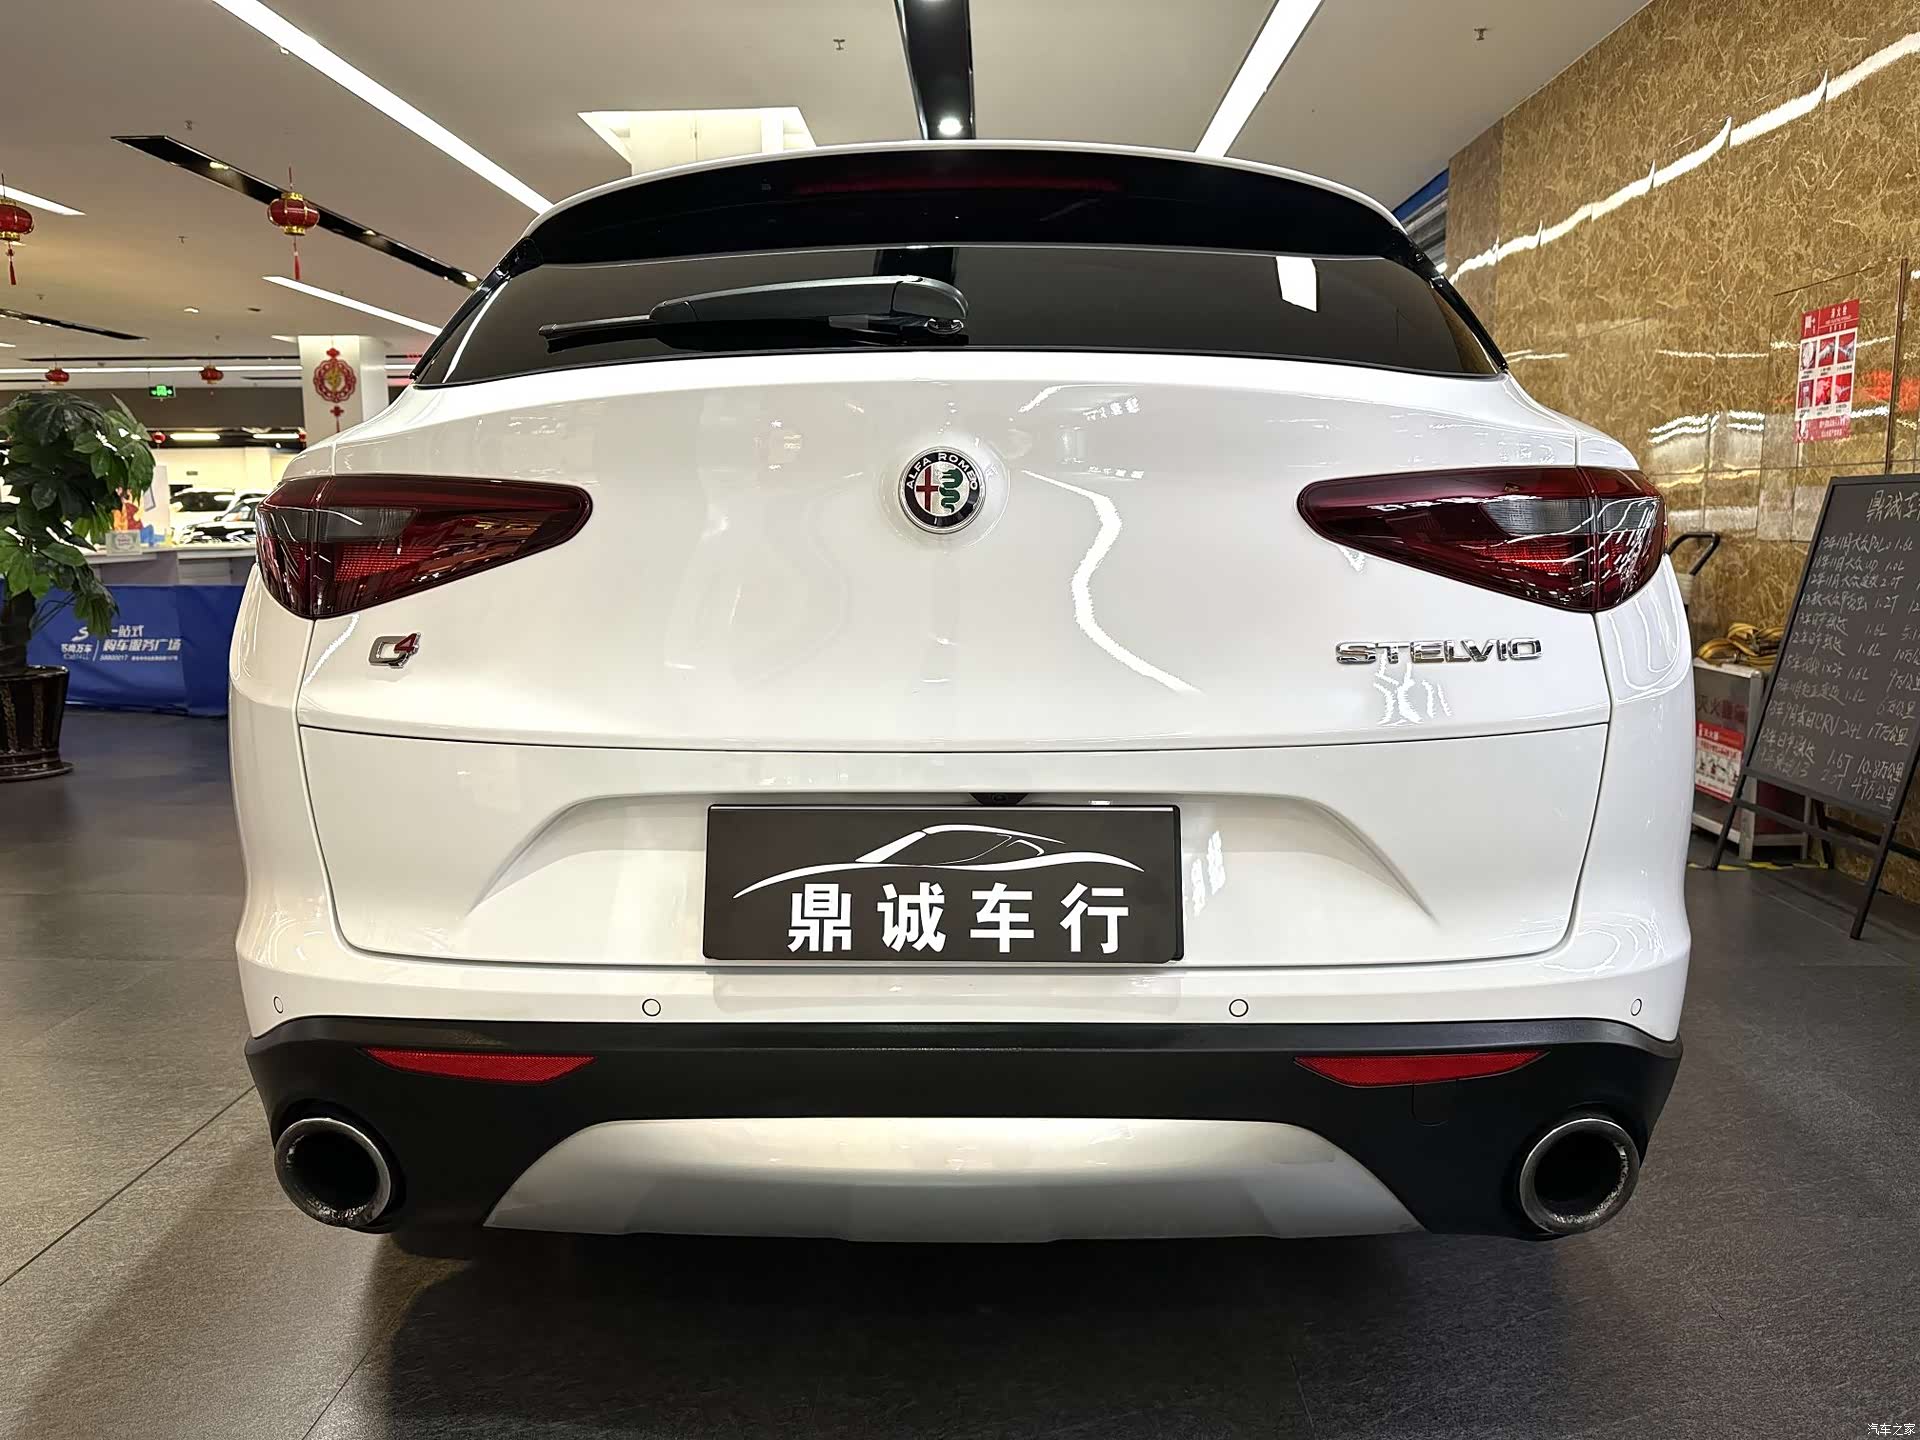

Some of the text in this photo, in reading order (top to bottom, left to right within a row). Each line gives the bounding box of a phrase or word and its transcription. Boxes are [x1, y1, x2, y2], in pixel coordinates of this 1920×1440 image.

[906, 452, 978, 491] ALFA ROMEO
[1866, 489, 1920, 522] 鼎诚车
[103, 638, 182, 652] 购车服务广场
[368, 632, 421, 669] Q4
[1335, 637, 1543, 664] STELVIO
[787, 882, 1129, 954] 鼎诚车行
